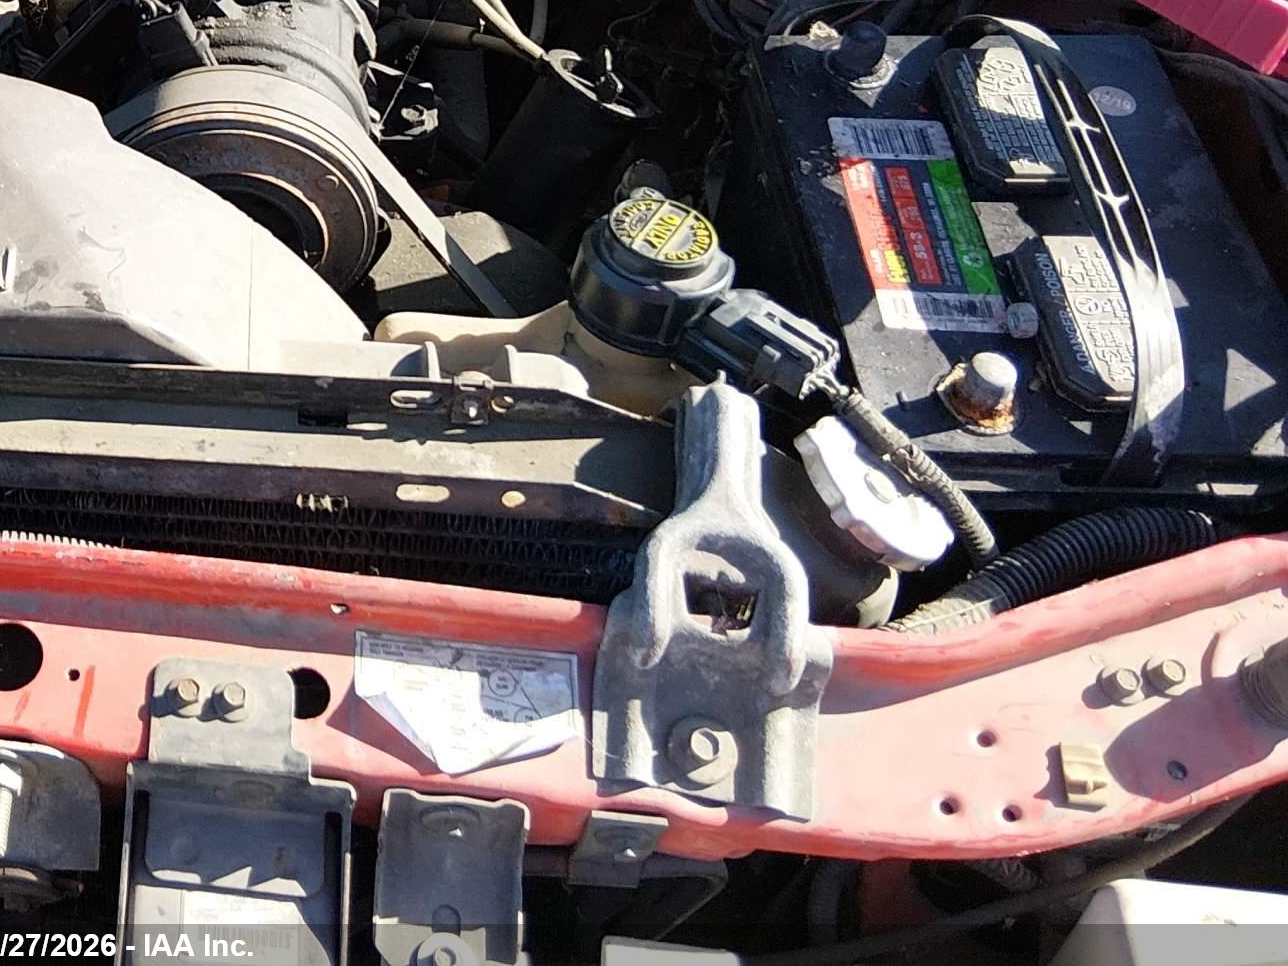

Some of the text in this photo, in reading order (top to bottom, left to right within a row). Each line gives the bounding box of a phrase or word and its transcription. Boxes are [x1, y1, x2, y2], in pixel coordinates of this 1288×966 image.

[643, 212, 681, 250] ONLY
[664, 215, 712, 261] RADIATOR
[1034, 252, 1063, 298] POISON
[1059, 309, 1090, 365] DANGER
